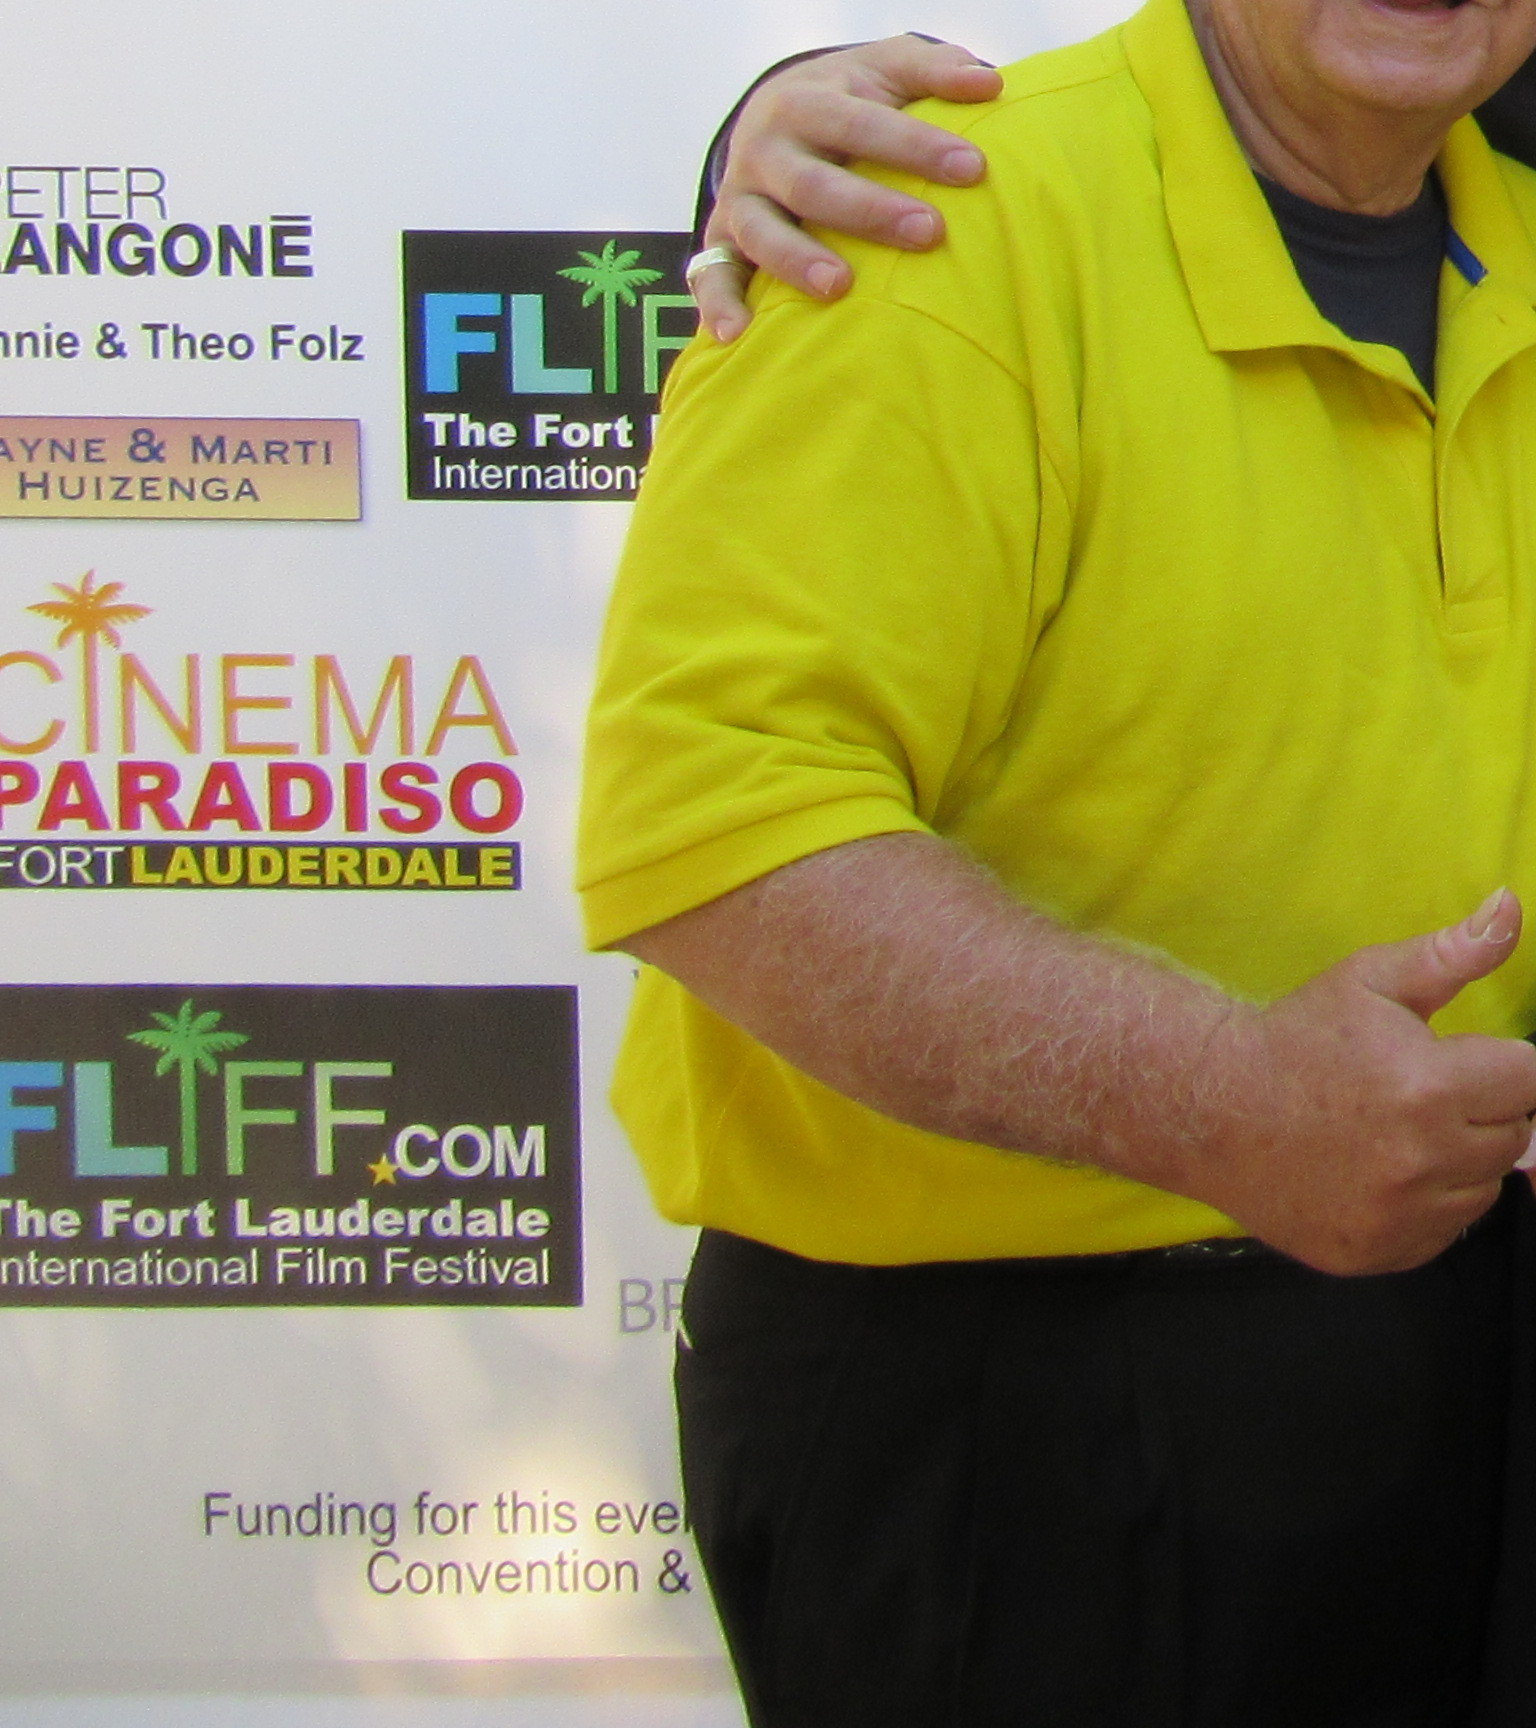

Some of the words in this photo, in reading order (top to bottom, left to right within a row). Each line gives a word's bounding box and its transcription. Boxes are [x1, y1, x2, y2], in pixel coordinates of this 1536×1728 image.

[96, 322, 128, 359] &
[142, 323, 255, 360] Theo
[271, 324, 365, 361] Folz
[128, 427, 166, 463] &
[191, 436, 332, 464] MARTI
[424, 413, 517, 448] The
[534, 414, 633, 448] Fort
[19, 472, 261, 502] HUIZENGA
[130, 846, 514, 888] LAUDERDALE
[101, 1199, 215, 1237] Fort
[235, 1199, 550, 1240] Lauderdale
[276, 1248, 366, 1286] Film
[384, 1249, 550, 1287] Festival
[203, 1491, 398, 1547] Funding
[414, 1490, 478, 1536] for
[494, 1490, 578, 1535] this
[368, 1550, 640, 1595] Convention
[658, 1548, 693, 1594] &
